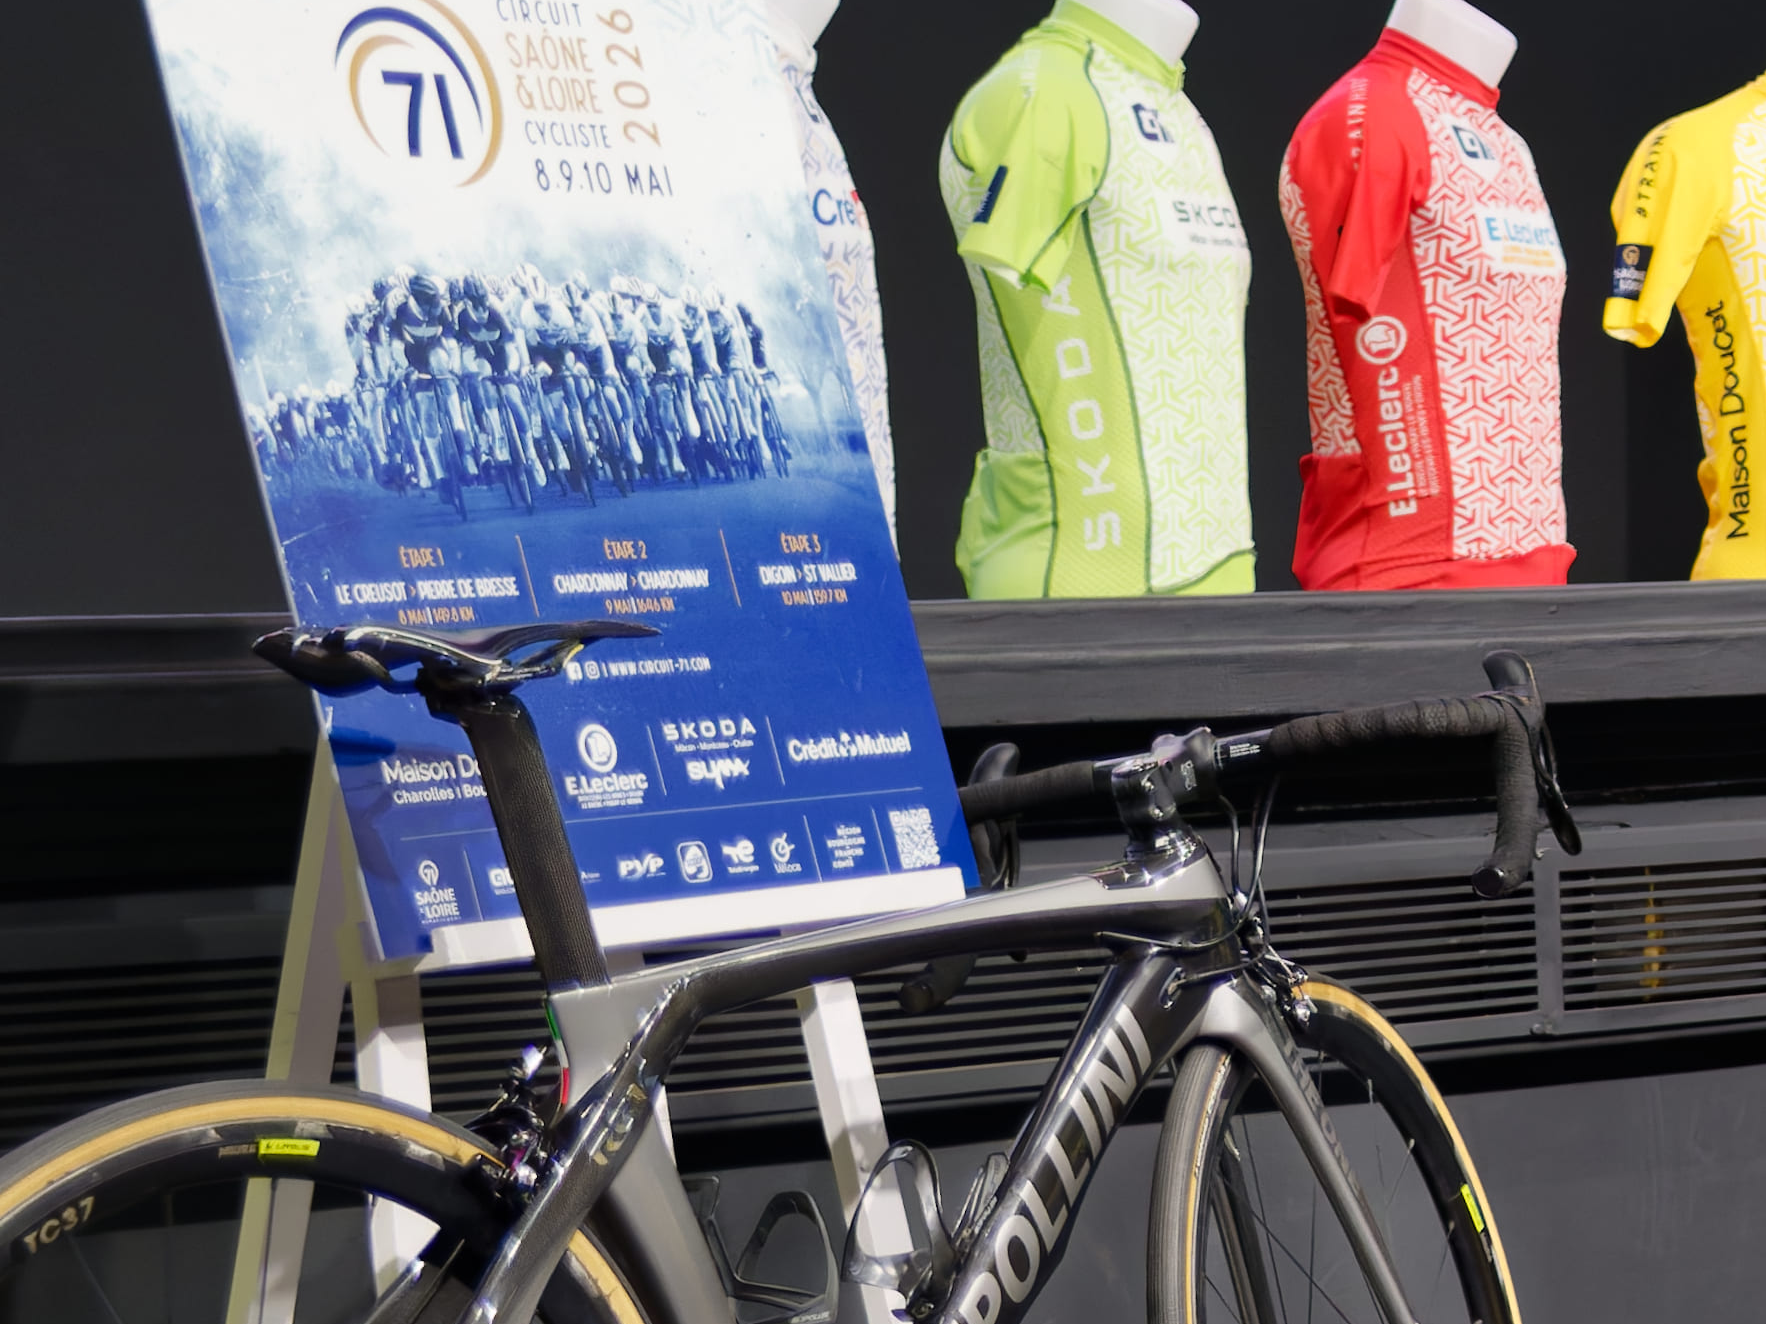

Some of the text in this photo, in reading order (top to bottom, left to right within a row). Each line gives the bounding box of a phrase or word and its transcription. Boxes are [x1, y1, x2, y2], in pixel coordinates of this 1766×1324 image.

[506, 28, 594, 73] SAÔNE
[597, 8, 662, 148] 2026
[381, 69, 464, 160] 71
[525, 119, 612, 149] CYCLISTE
[624, 163, 674, 197] MAI
[1042, 273, 1121, 551] SKODA
[1705, 299, 1750, 540] Doucet Maison
[1377, 365, 1418, 517] E.Leclerc
[399, 545, 436, 568] ÉTAPE
[638, 540, 648, 559] 2
[335, 577, 520, 605] LE CREUSOT PIERRE DE BRESSE
[553, 569, 710, 594] CHARDONNAY CHARDONNAY
[407, 608, 427, 625] MAI
[614, 599, 631, 613] MAI
[788, 731, 912, 762] Crédit Mutuel
[381, 759, 451, 785] Maison
[564, 772, 648, 797] E.Leclerc
[393, 783, 455, 805] Charolles
[415, 887, 456, 906] SAÔNE
[425, 903, 460, 919] LOIRE
[23, 1196, 95, 1254] TC37
